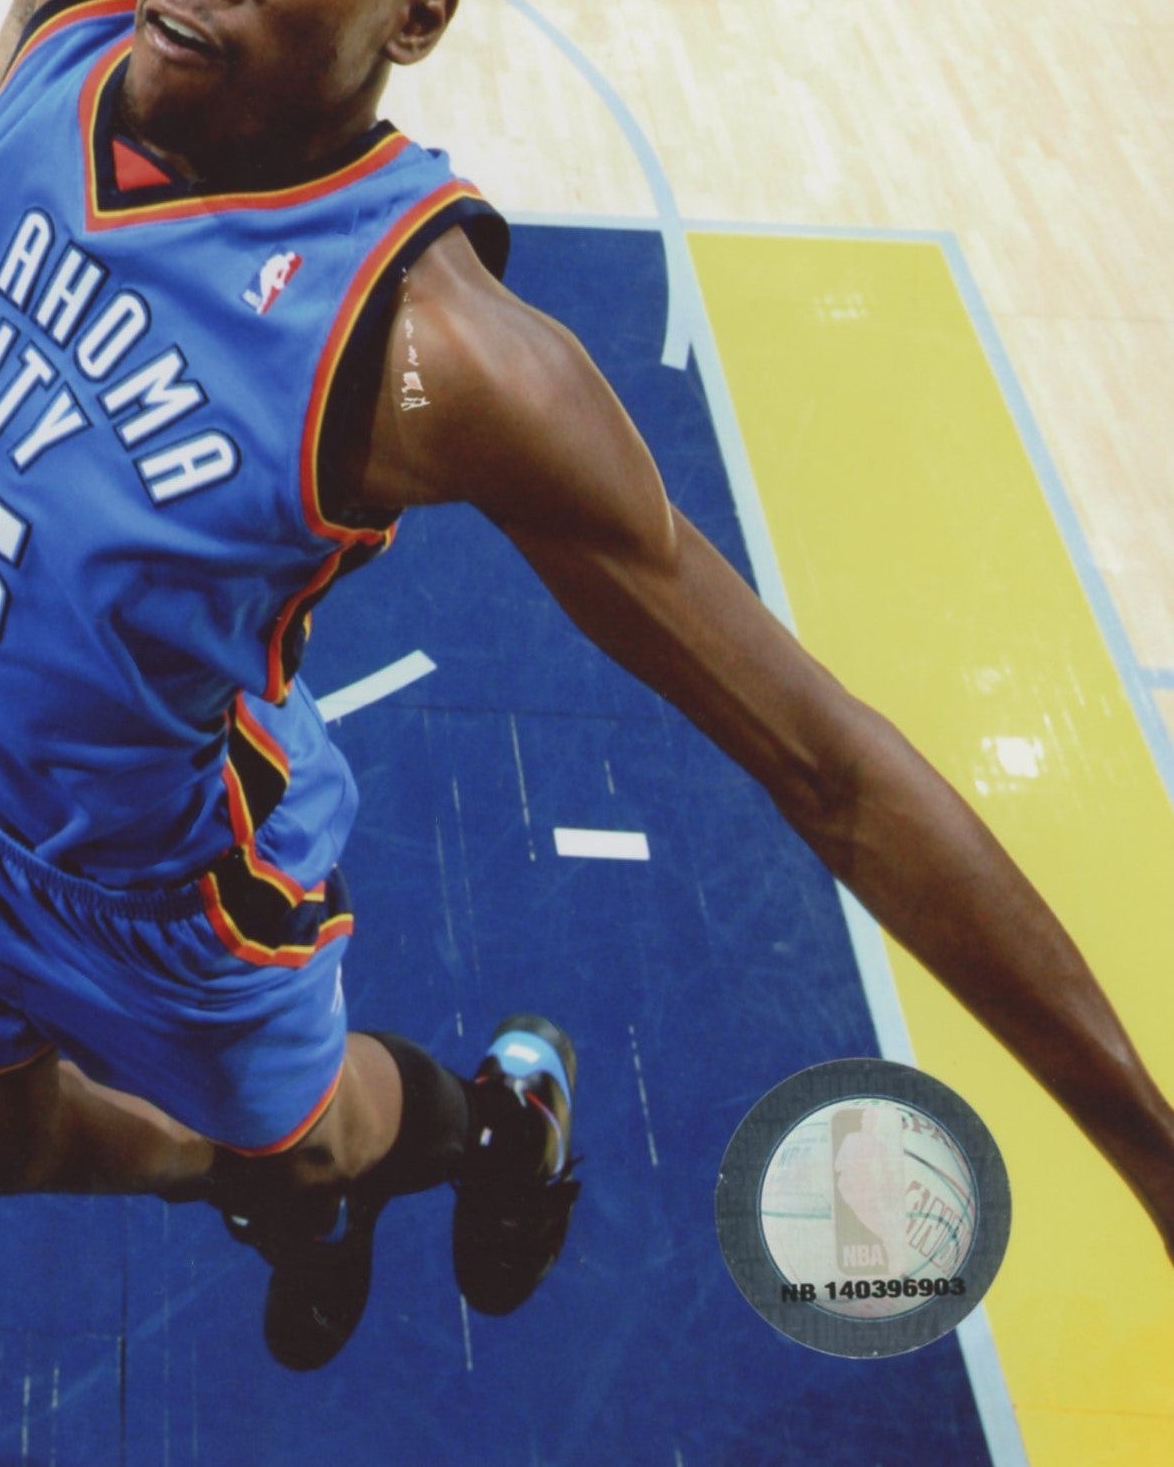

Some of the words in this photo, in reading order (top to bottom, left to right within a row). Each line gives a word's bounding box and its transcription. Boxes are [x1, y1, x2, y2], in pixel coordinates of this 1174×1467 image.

[843, 1244, 884, 1268] NBA
[781, 1282, 817, 1302] NB
[824, 1278, 967, 1300] 140396903
